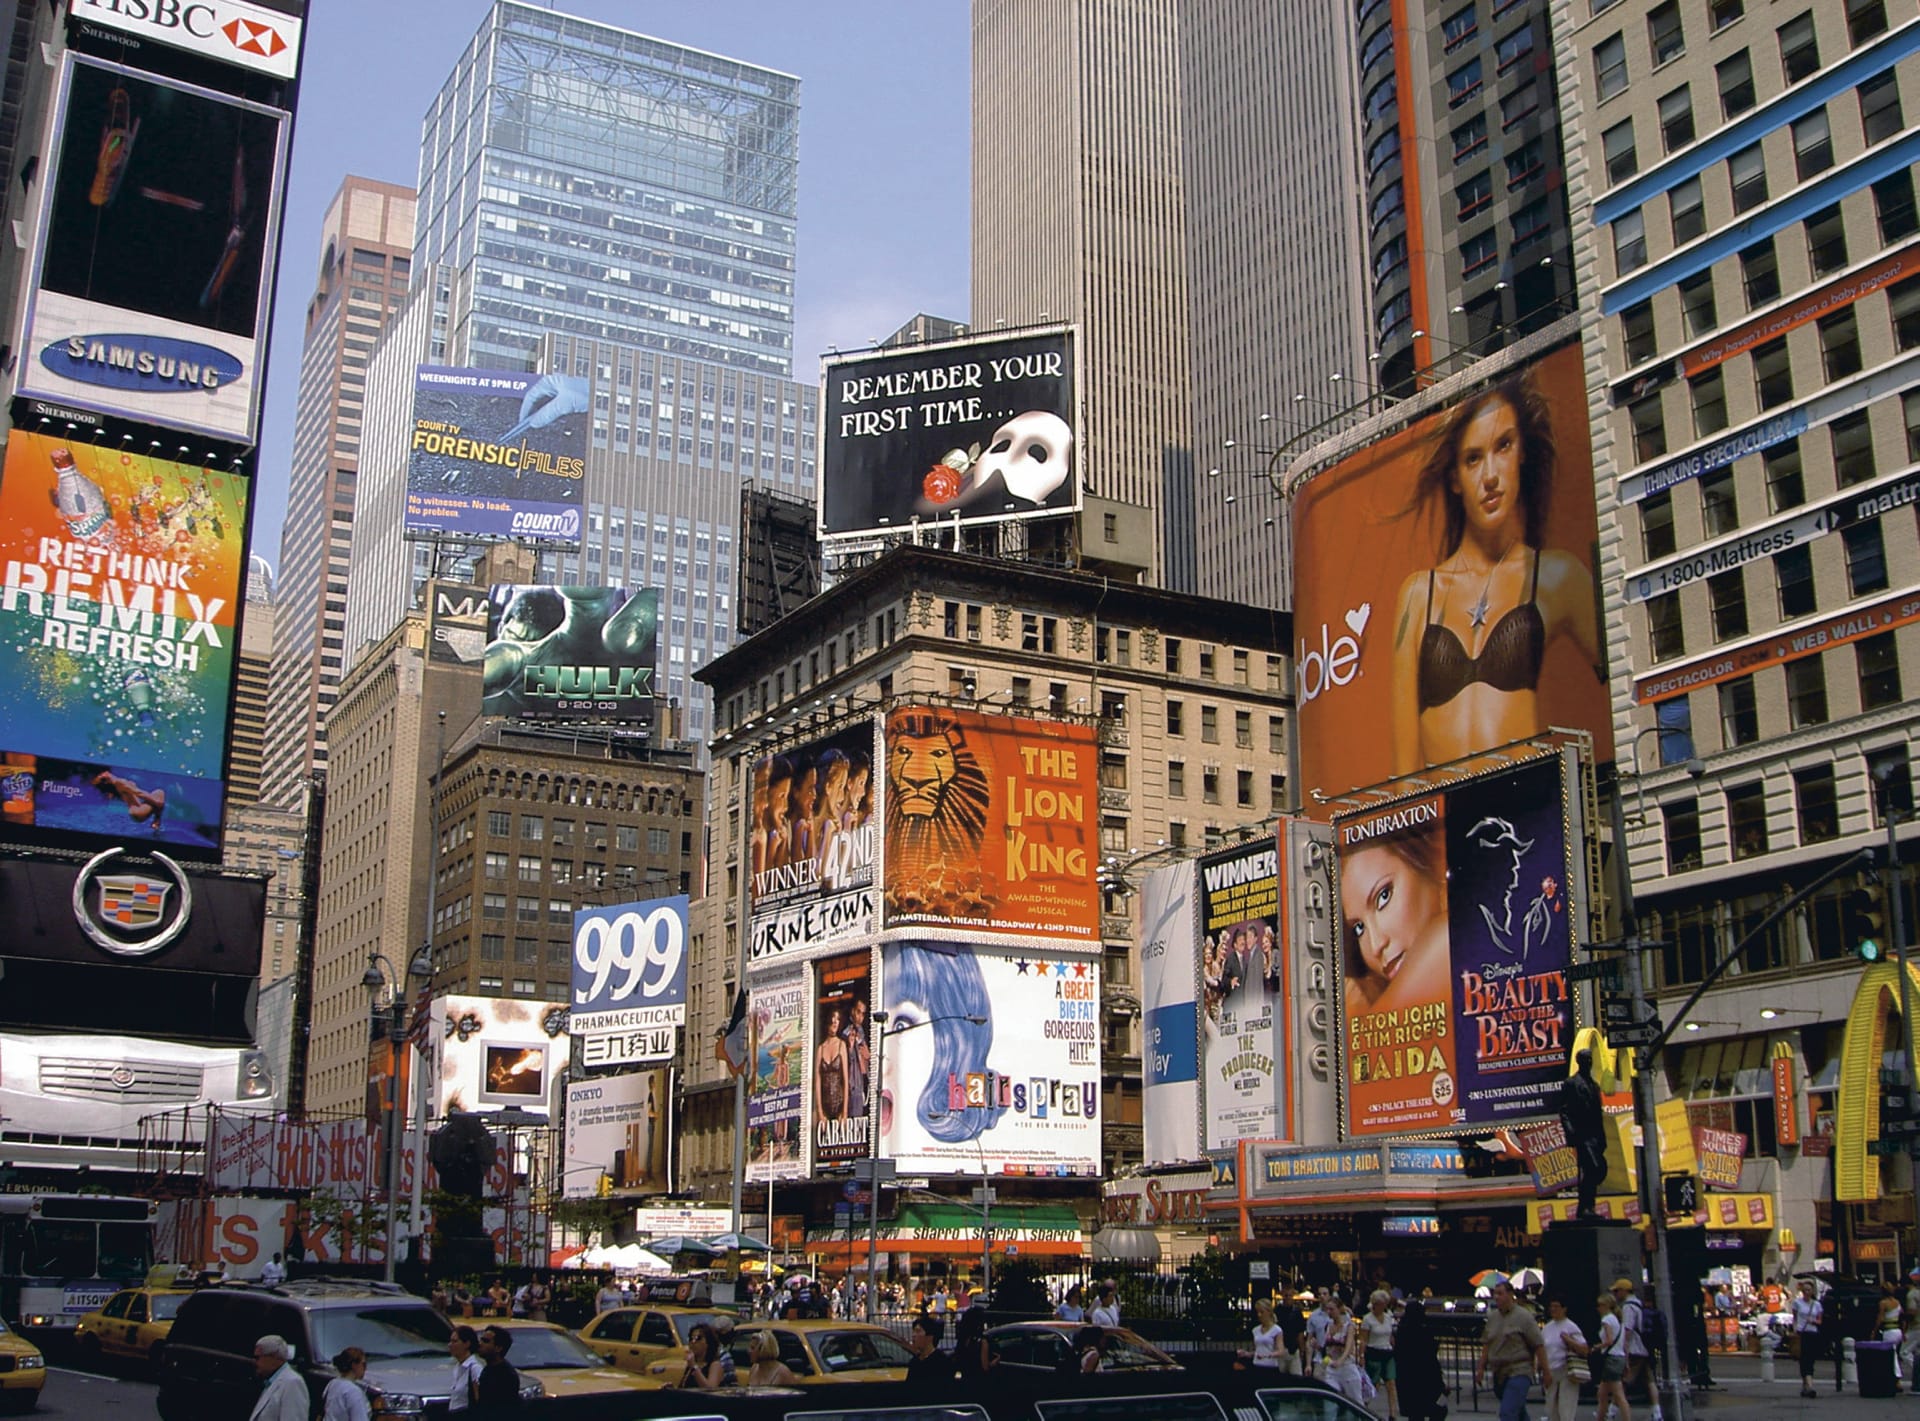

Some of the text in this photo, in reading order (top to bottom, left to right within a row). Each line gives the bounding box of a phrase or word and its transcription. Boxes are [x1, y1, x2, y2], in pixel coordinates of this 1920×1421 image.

[81, 24, 140, 48] SHERWOOD
[1701, 347, 1723, 362] Why
[1726, 330, 1761, 351] haven't
[1770, 317, 1791, 331] ever
[1795, 304, 1818, 321] seen
[1831, 284, 1856, 305] baby
[1861, 262, 1903, 295] pigeon?
[68, 335, 218, 388] SAMSUNG
[420, 373, 477, 386] WEEKNIGHTS
[479, 379, 490, 387] AT
[491, 380, 511, 388] 9PM
[842, 352, 1063, 404] REMEMBER YOUR
[36, 403, 96, 425] SHERWOOD
[841, 406, 912, 437] FIRST
[417, 419, 460, 434] COURT TV
[413, 431, 584, 479] FORENSIC FILES
[1645, 417, 1793, 493] THINKING SPECTACULAR?
[408, 505, 421, 514] No
[409, 495, 421, 504] No
[472, 500, 485, 509] No
[512, 512, 561, 530] COURT
[39, 537, 192, 590] RETHINK
[3, 560, 225, 648] REMIX
[43, 619, 199, 671] REFRESH
[1646, 661, 1733, 697] SPECTACOLOR
[1792, 631, 1828, 652] WEB
[1831, 615, 1877, 640] WALL
[524, 664, 653, 699] HULK
[1021, 747, 1077, 780] THE
[42, 780, 83, 798] Plunge.
[1006, 776, 1083, 827] LION
[1343, 801, 1438, 845] TONI BRAXTON
[1006, 830, 1087, 882] KING
[1204, 850, 1277, 892] WINNER
[1007, 892, 1088, 908] AWARD-WINNING
[1039, 884, 1056, 894] THE
[1028, 906, 1067, 917] MUSICAL
[991, 920, 1036, 930] BROADWAY
[1065, 925, 1091, 935] STREET
[575, 906, 683, 1005] 999
[1304, 841, 1329, 1080] PALACE
[1481, 961, 1523, 980] Disney's
[1056, 981, 1095, 999] A GREAT
[1461, 969, 1568, 1016] BEAUTY
[575, 1009, 678, 1030] PHARMACEUTICAL
[1059, 1001, 1095, 1020] BIG FAT
[1403, 1001, 1446, 1025] JOHN
[1501, 1005, 1555, 1024] AND THE
[1044, 1020, 1095, 1040] GORGEOUS
[1352, 1020, 1447, 1050] & TIM RICE'S
[1476, 1014, 1563, 1058] BEAST
[586, 1031, 670, 1061] 三九药业
[1237, 1034, 1254, 1052] THE
[1221, 1052, 1274, 1081] PRODUCERS
[1372, 1045, 1448, 1081] AIDA
[1478, 1053, 1565, 1071] BROADWAY'S CLASSIC MUSICAL
[570, 1087, 602, 1102] ONKYO
[948, 1072, 1097, 1119] hairspray
[1434, 1084, 1452, 1099] $25
[1539, 1081, 1565, 1092] THEAT
[602, 1105, 614, 1114] home
[1383, 1097, 1434, 1111] PALACE THEATRE
[1450, 1108, 1466, 1118] VISA
[579, 1117, 594, 1126] without
[603, 1115, 615, 1123] home
[616, 1113, 630, 1123] equity
[818, 1116, 868, 1147] CABARET
[1524, 1123, 1564, 1147] TIMES
[1704, 1129, 1741, 1147] TIMES
[330, 1122, 364, 1182] tkts
[1702, 1141, 1739, 1155] SQUARE
[1268, 1153, 1380, 1178] TONI BRAXTON IS AIDA
[1533, 1147, 1578, 1178] VISITORS
[1702, 1151, 1741, 1175] VISITORS
[1539, 1167, 1578, 1188] CENTER
[1700, 1169, 1737, 1185] CENTER
[914, 1226, 960, 1240] sbarro
[1030, 1228, 1075, 1242] sbarro
